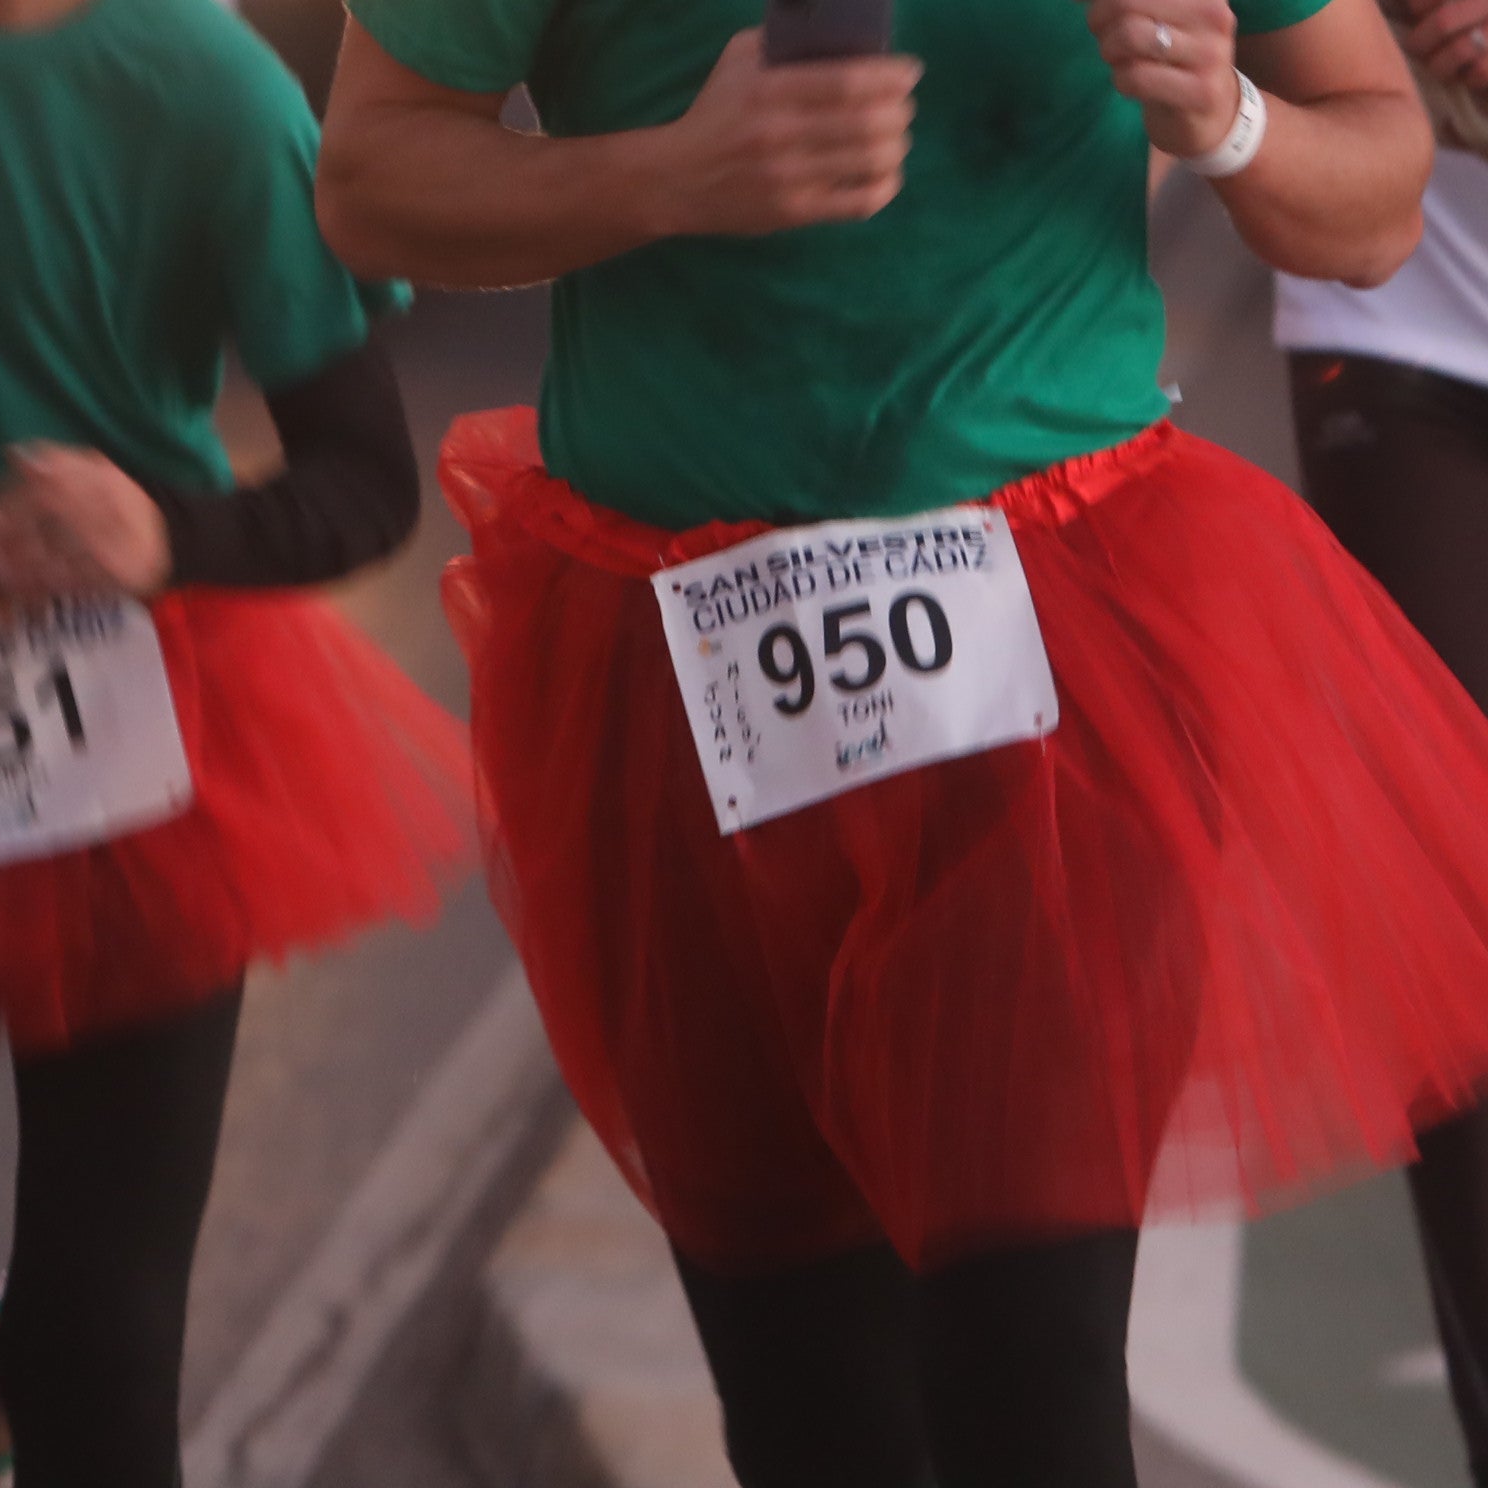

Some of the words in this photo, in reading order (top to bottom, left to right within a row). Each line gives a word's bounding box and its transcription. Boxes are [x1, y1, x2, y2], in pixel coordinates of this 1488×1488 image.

[683, 560, 761, 609] SAN
[766, 523, 985, 577] SILVESTRE
[692, 568, 817, 634] CIUDAD
[825, 556, 875, 590] DE
[757, 586, 954, 720] 950
